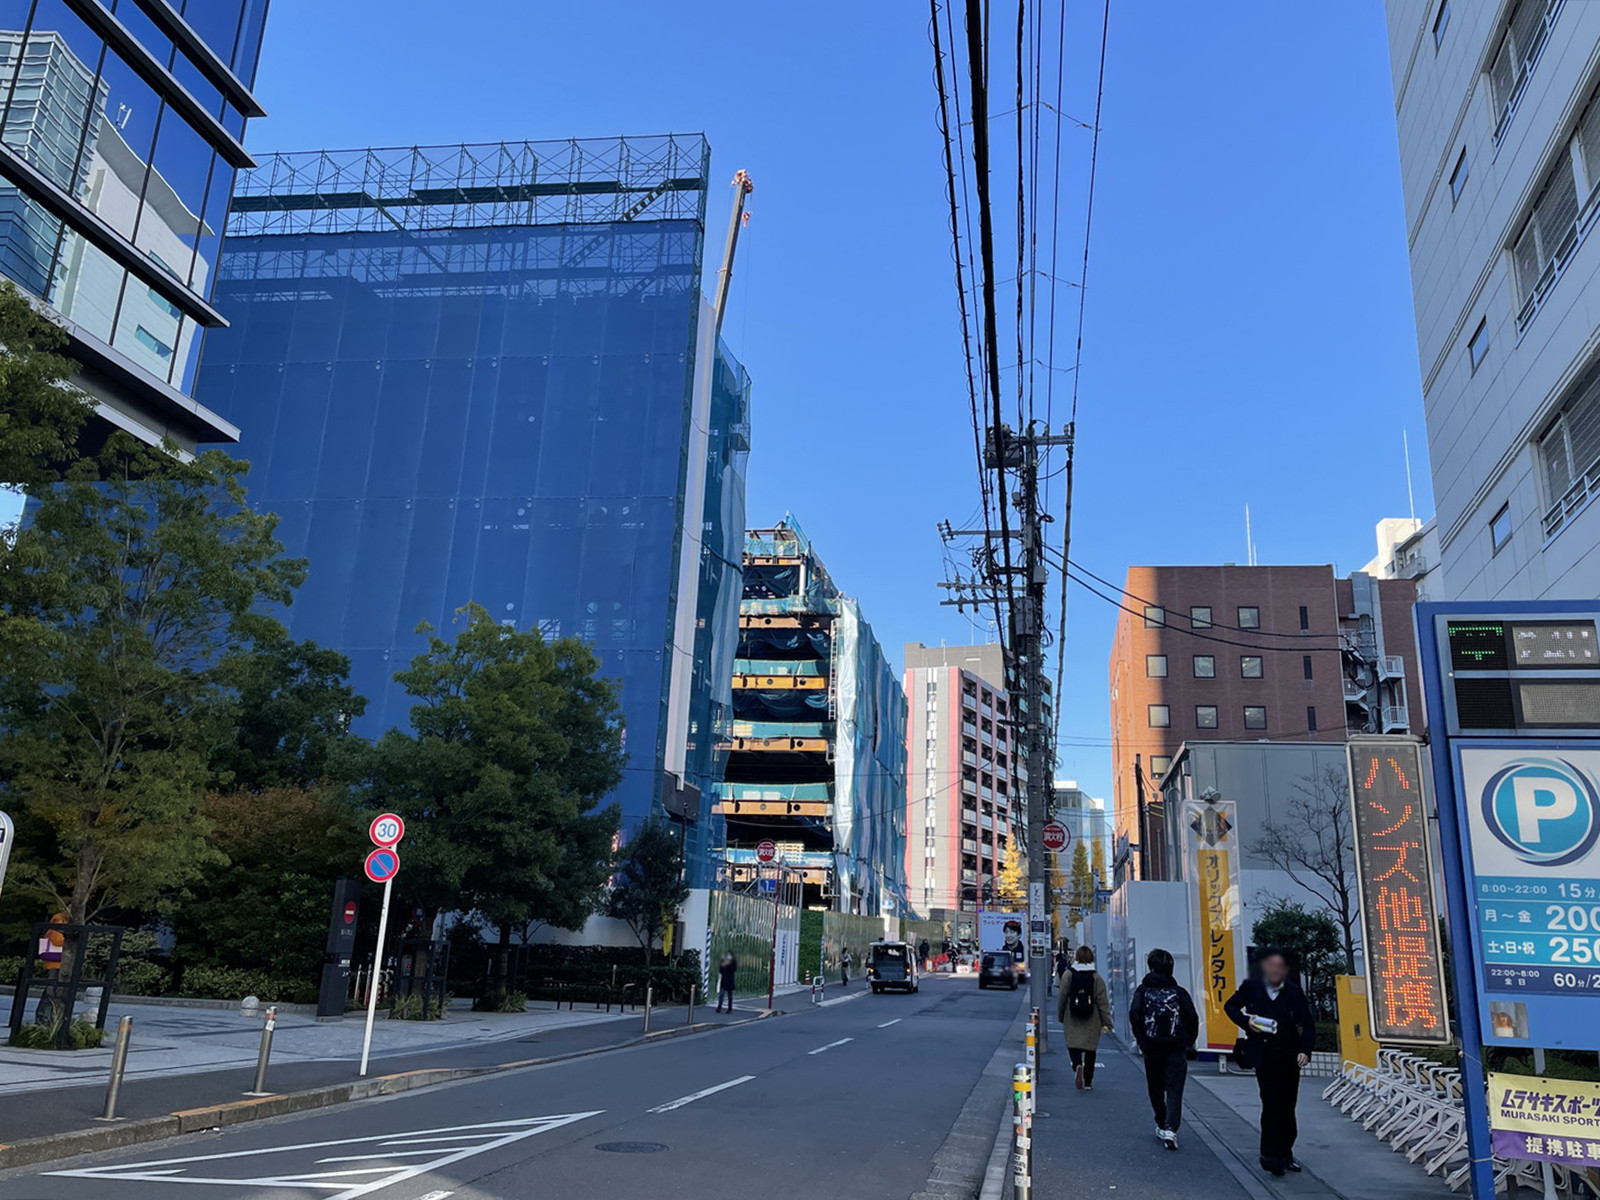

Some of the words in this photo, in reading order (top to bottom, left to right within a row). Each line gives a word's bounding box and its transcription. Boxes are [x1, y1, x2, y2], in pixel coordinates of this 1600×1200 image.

[1512, 776, 1577, 843] P
[377, 822, 397, 838] 30
[1365, 757, 1437, 1028] ハンズ他提携
[1501, 1109, 1560, 1123] MURASAKI
[1525, 1136, 1600, 1160] 提携駐車
